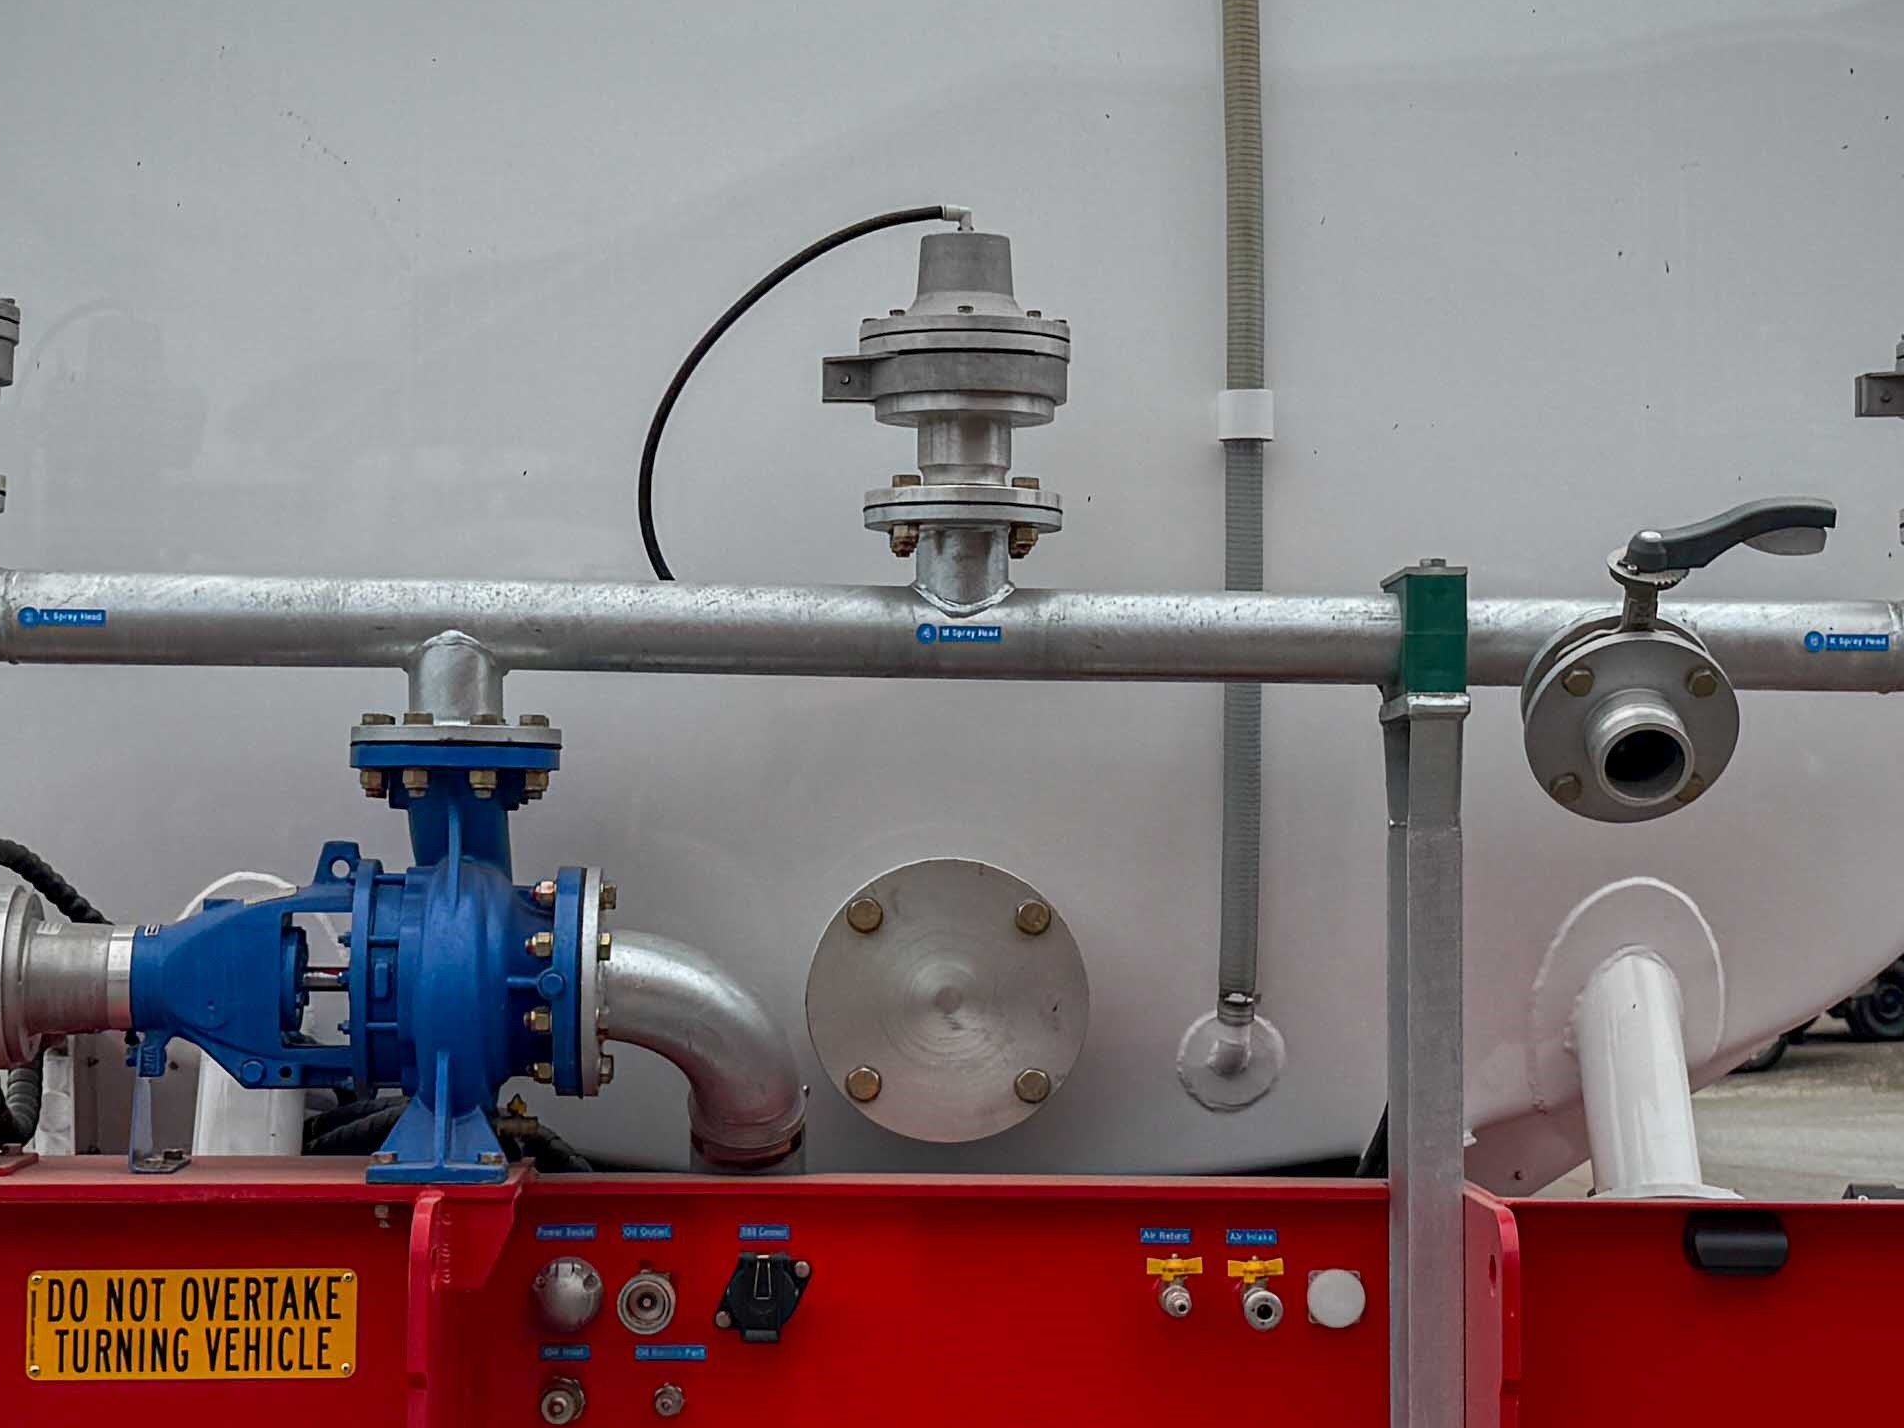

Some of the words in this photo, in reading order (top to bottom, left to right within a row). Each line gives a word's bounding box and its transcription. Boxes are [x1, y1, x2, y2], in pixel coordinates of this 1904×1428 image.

[47, 1277, 89, 1323] DO
[106, 1277, 167, 1323] NOT
[181, 1275, 343, 1322] OVERTAKE
[55, 1327, 189, 1373] TURNING
[205, 1326, 333, 1372] VEHICLE
